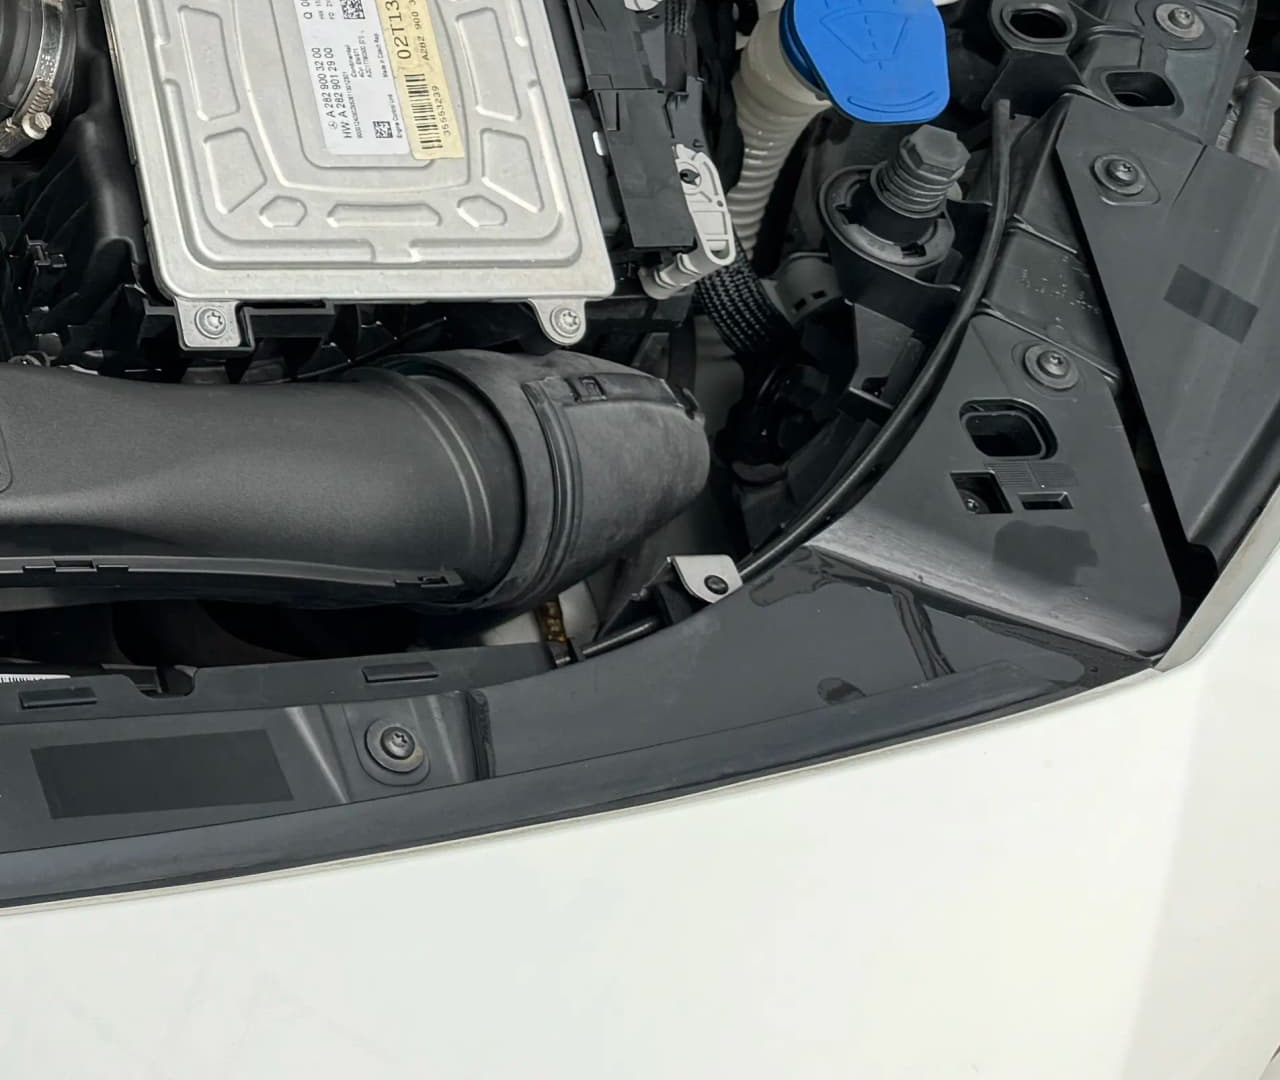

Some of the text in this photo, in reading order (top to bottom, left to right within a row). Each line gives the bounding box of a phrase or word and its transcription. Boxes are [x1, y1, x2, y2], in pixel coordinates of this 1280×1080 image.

[323, 47, 334, 58] 00
[311, 47, 336, 118] A 282 900 32 00
[330, 75, 341, 90] 901
[338, 110, 348, 118] A
[341, 122, 352, 138] HW
